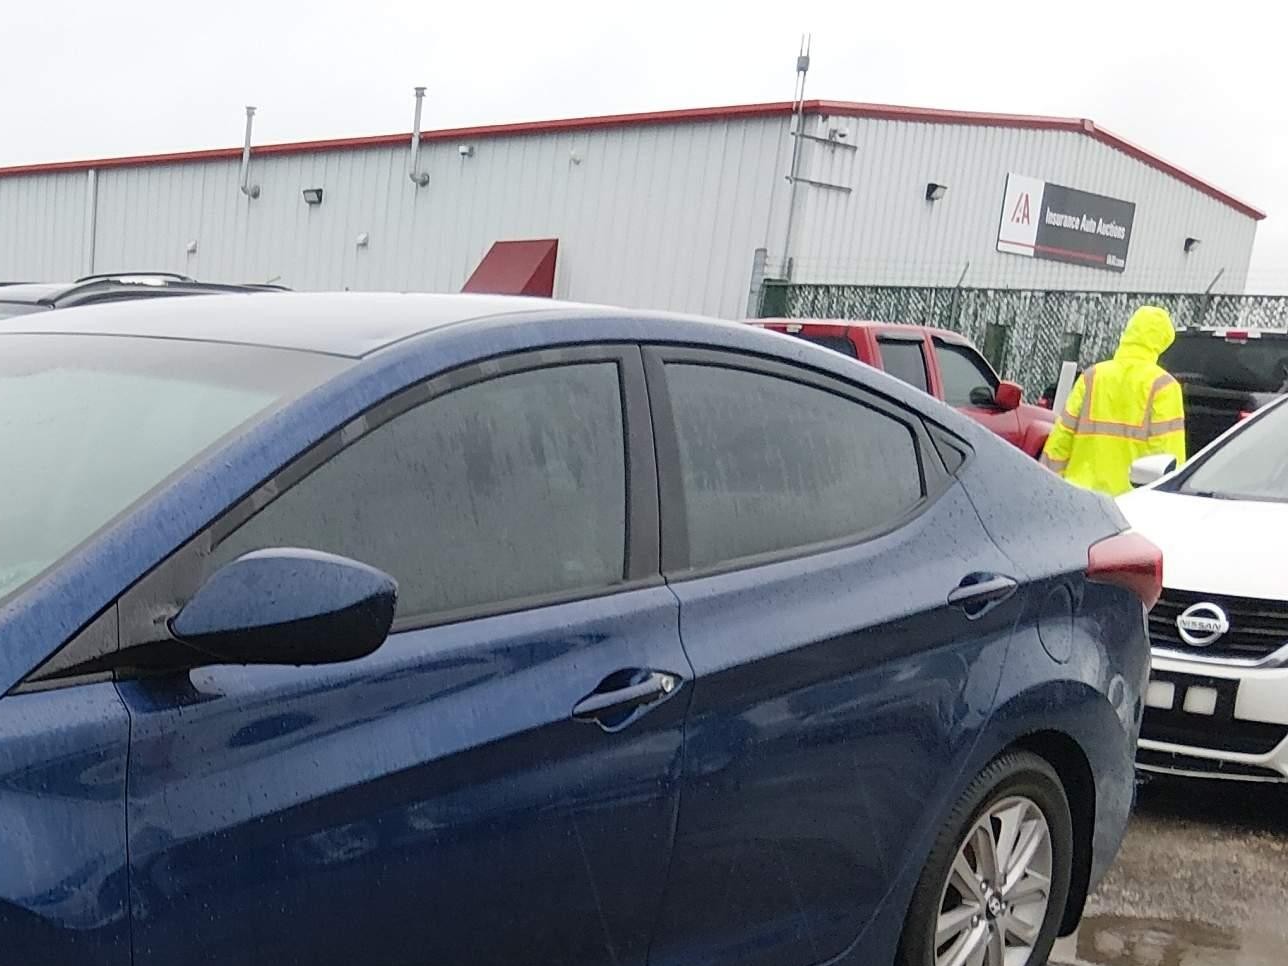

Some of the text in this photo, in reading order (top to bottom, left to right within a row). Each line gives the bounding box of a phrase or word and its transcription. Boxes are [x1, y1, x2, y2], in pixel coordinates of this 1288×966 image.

[1045, 206, 1125, 240] Insurance Auto Auctions
[1181, 618, 1222, 631] NISSAN
